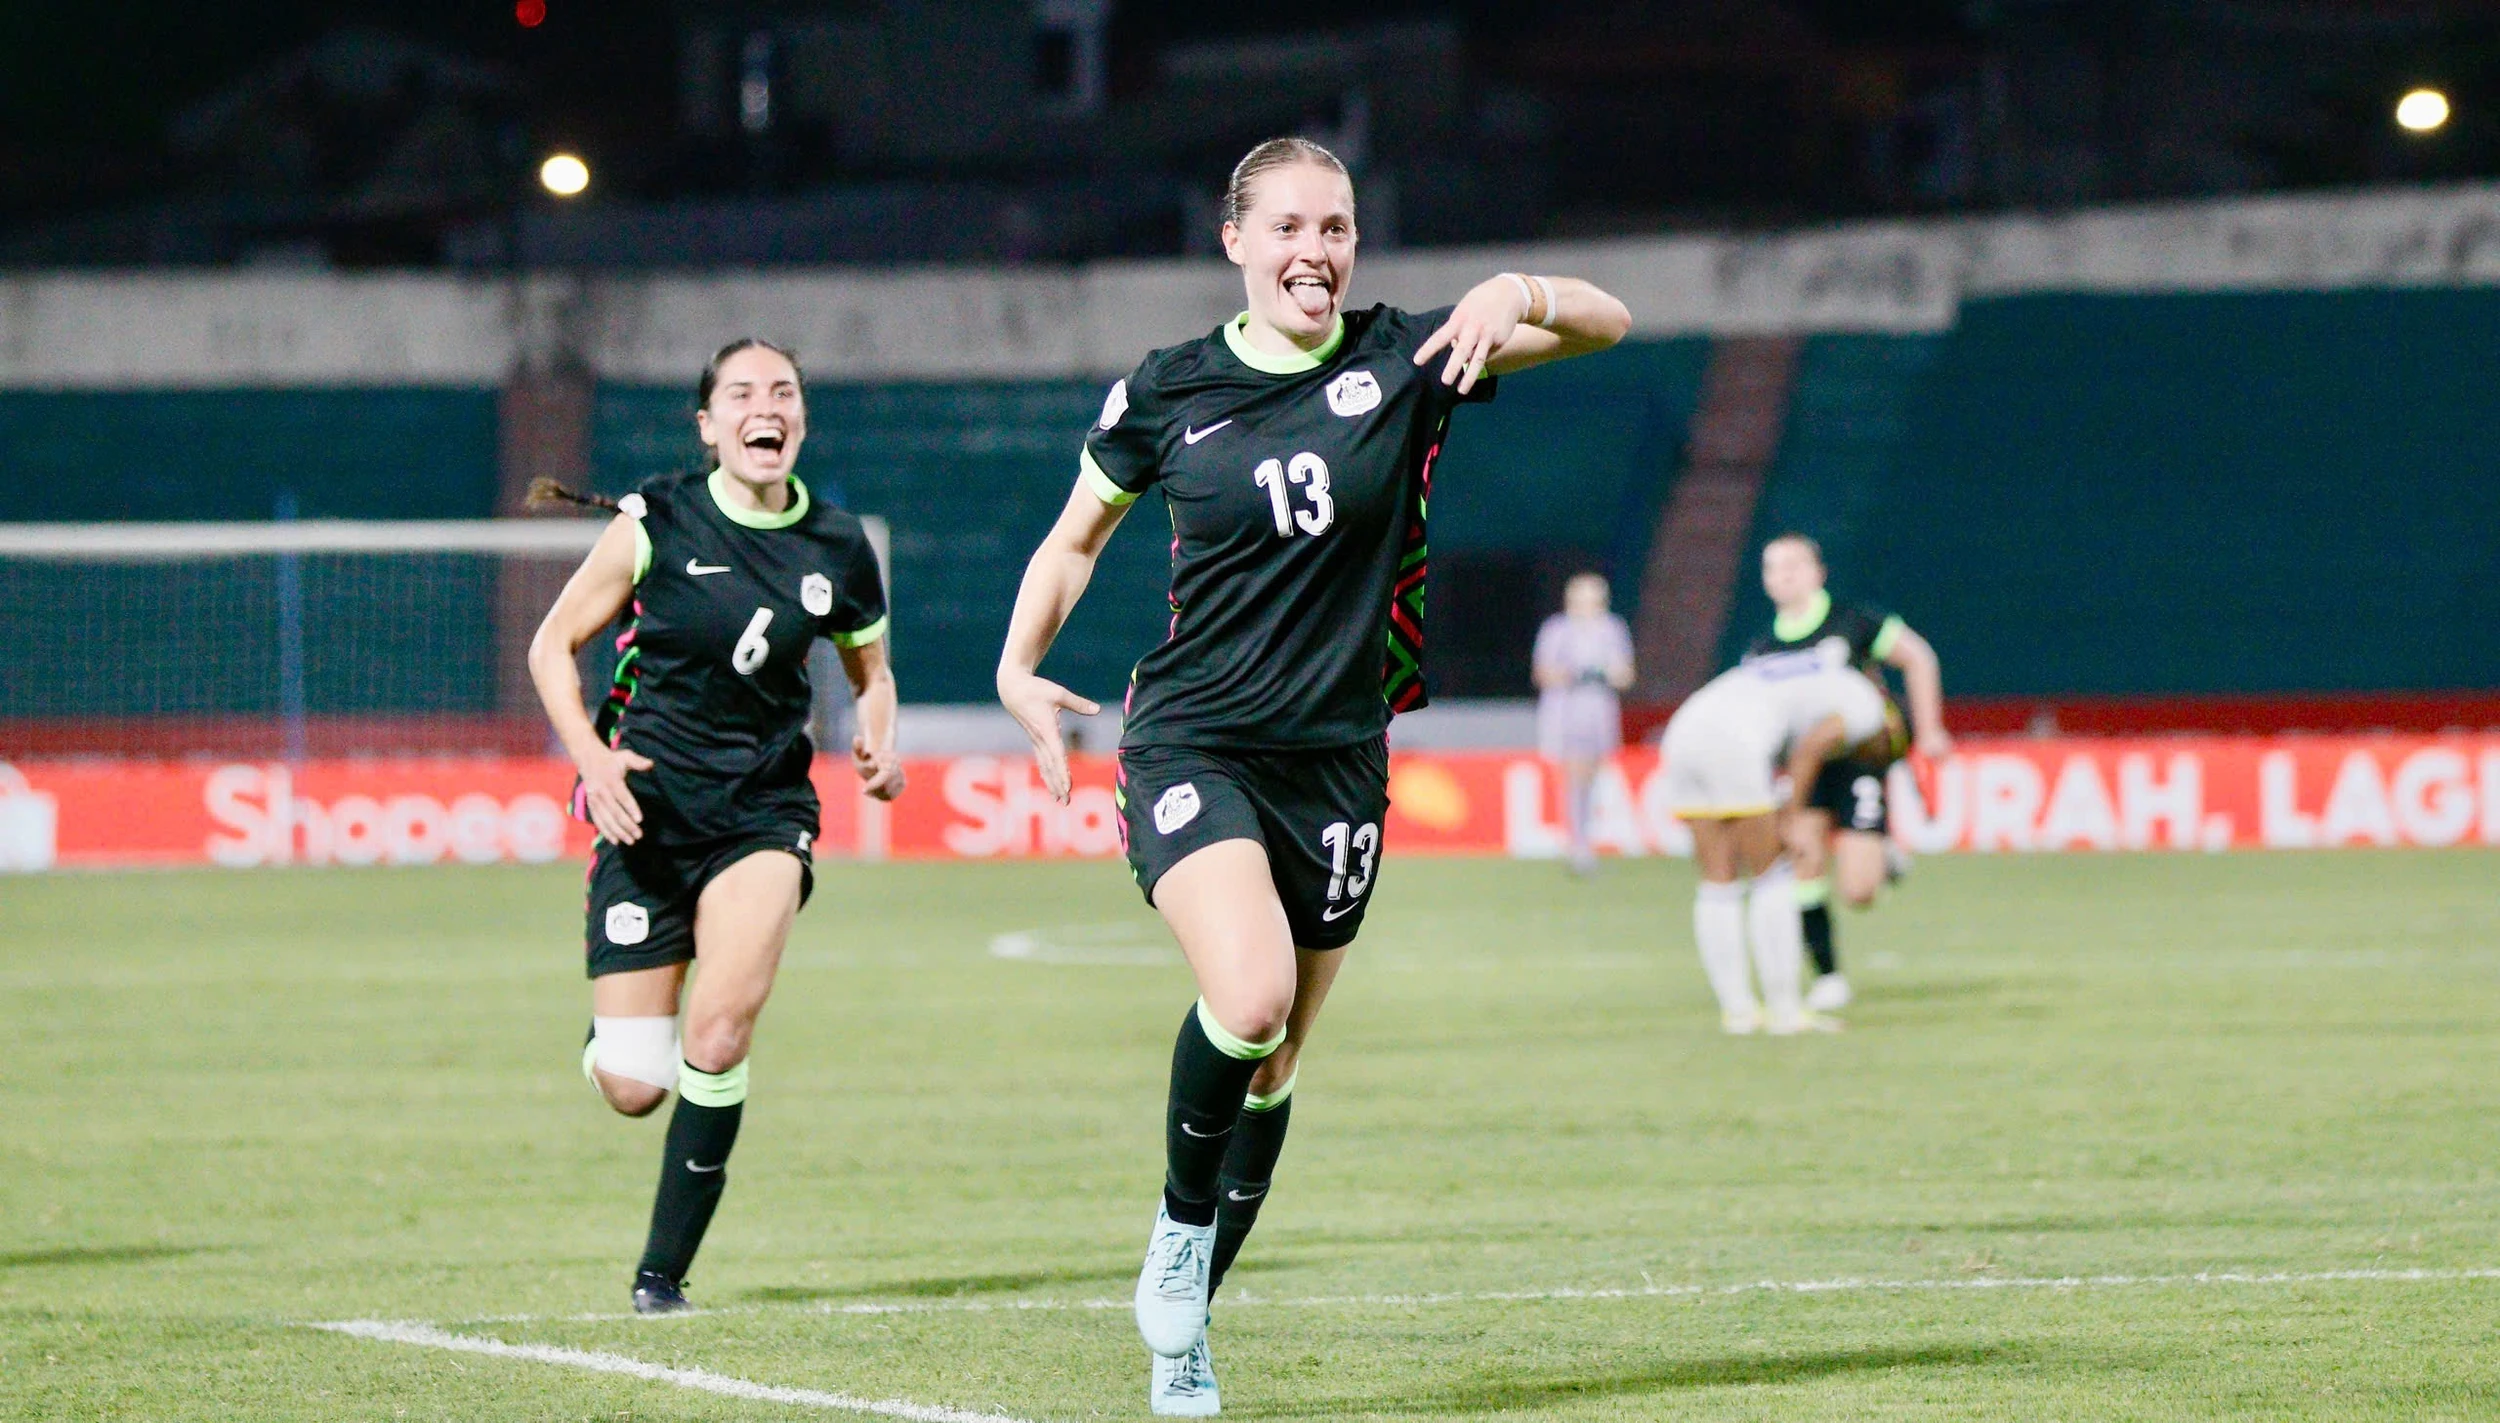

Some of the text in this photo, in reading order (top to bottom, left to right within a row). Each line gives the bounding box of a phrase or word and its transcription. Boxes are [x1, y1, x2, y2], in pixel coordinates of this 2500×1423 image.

[1254, 452, 1334, 538] 13
[732, 606, 774, 675] 6
[204, 764, 566, 867] Shopee
[942, 757, 1121, 857] Sho
[1886, 752, 2236, 853] URAH.
[1322, 822, 1379, 900] 13
